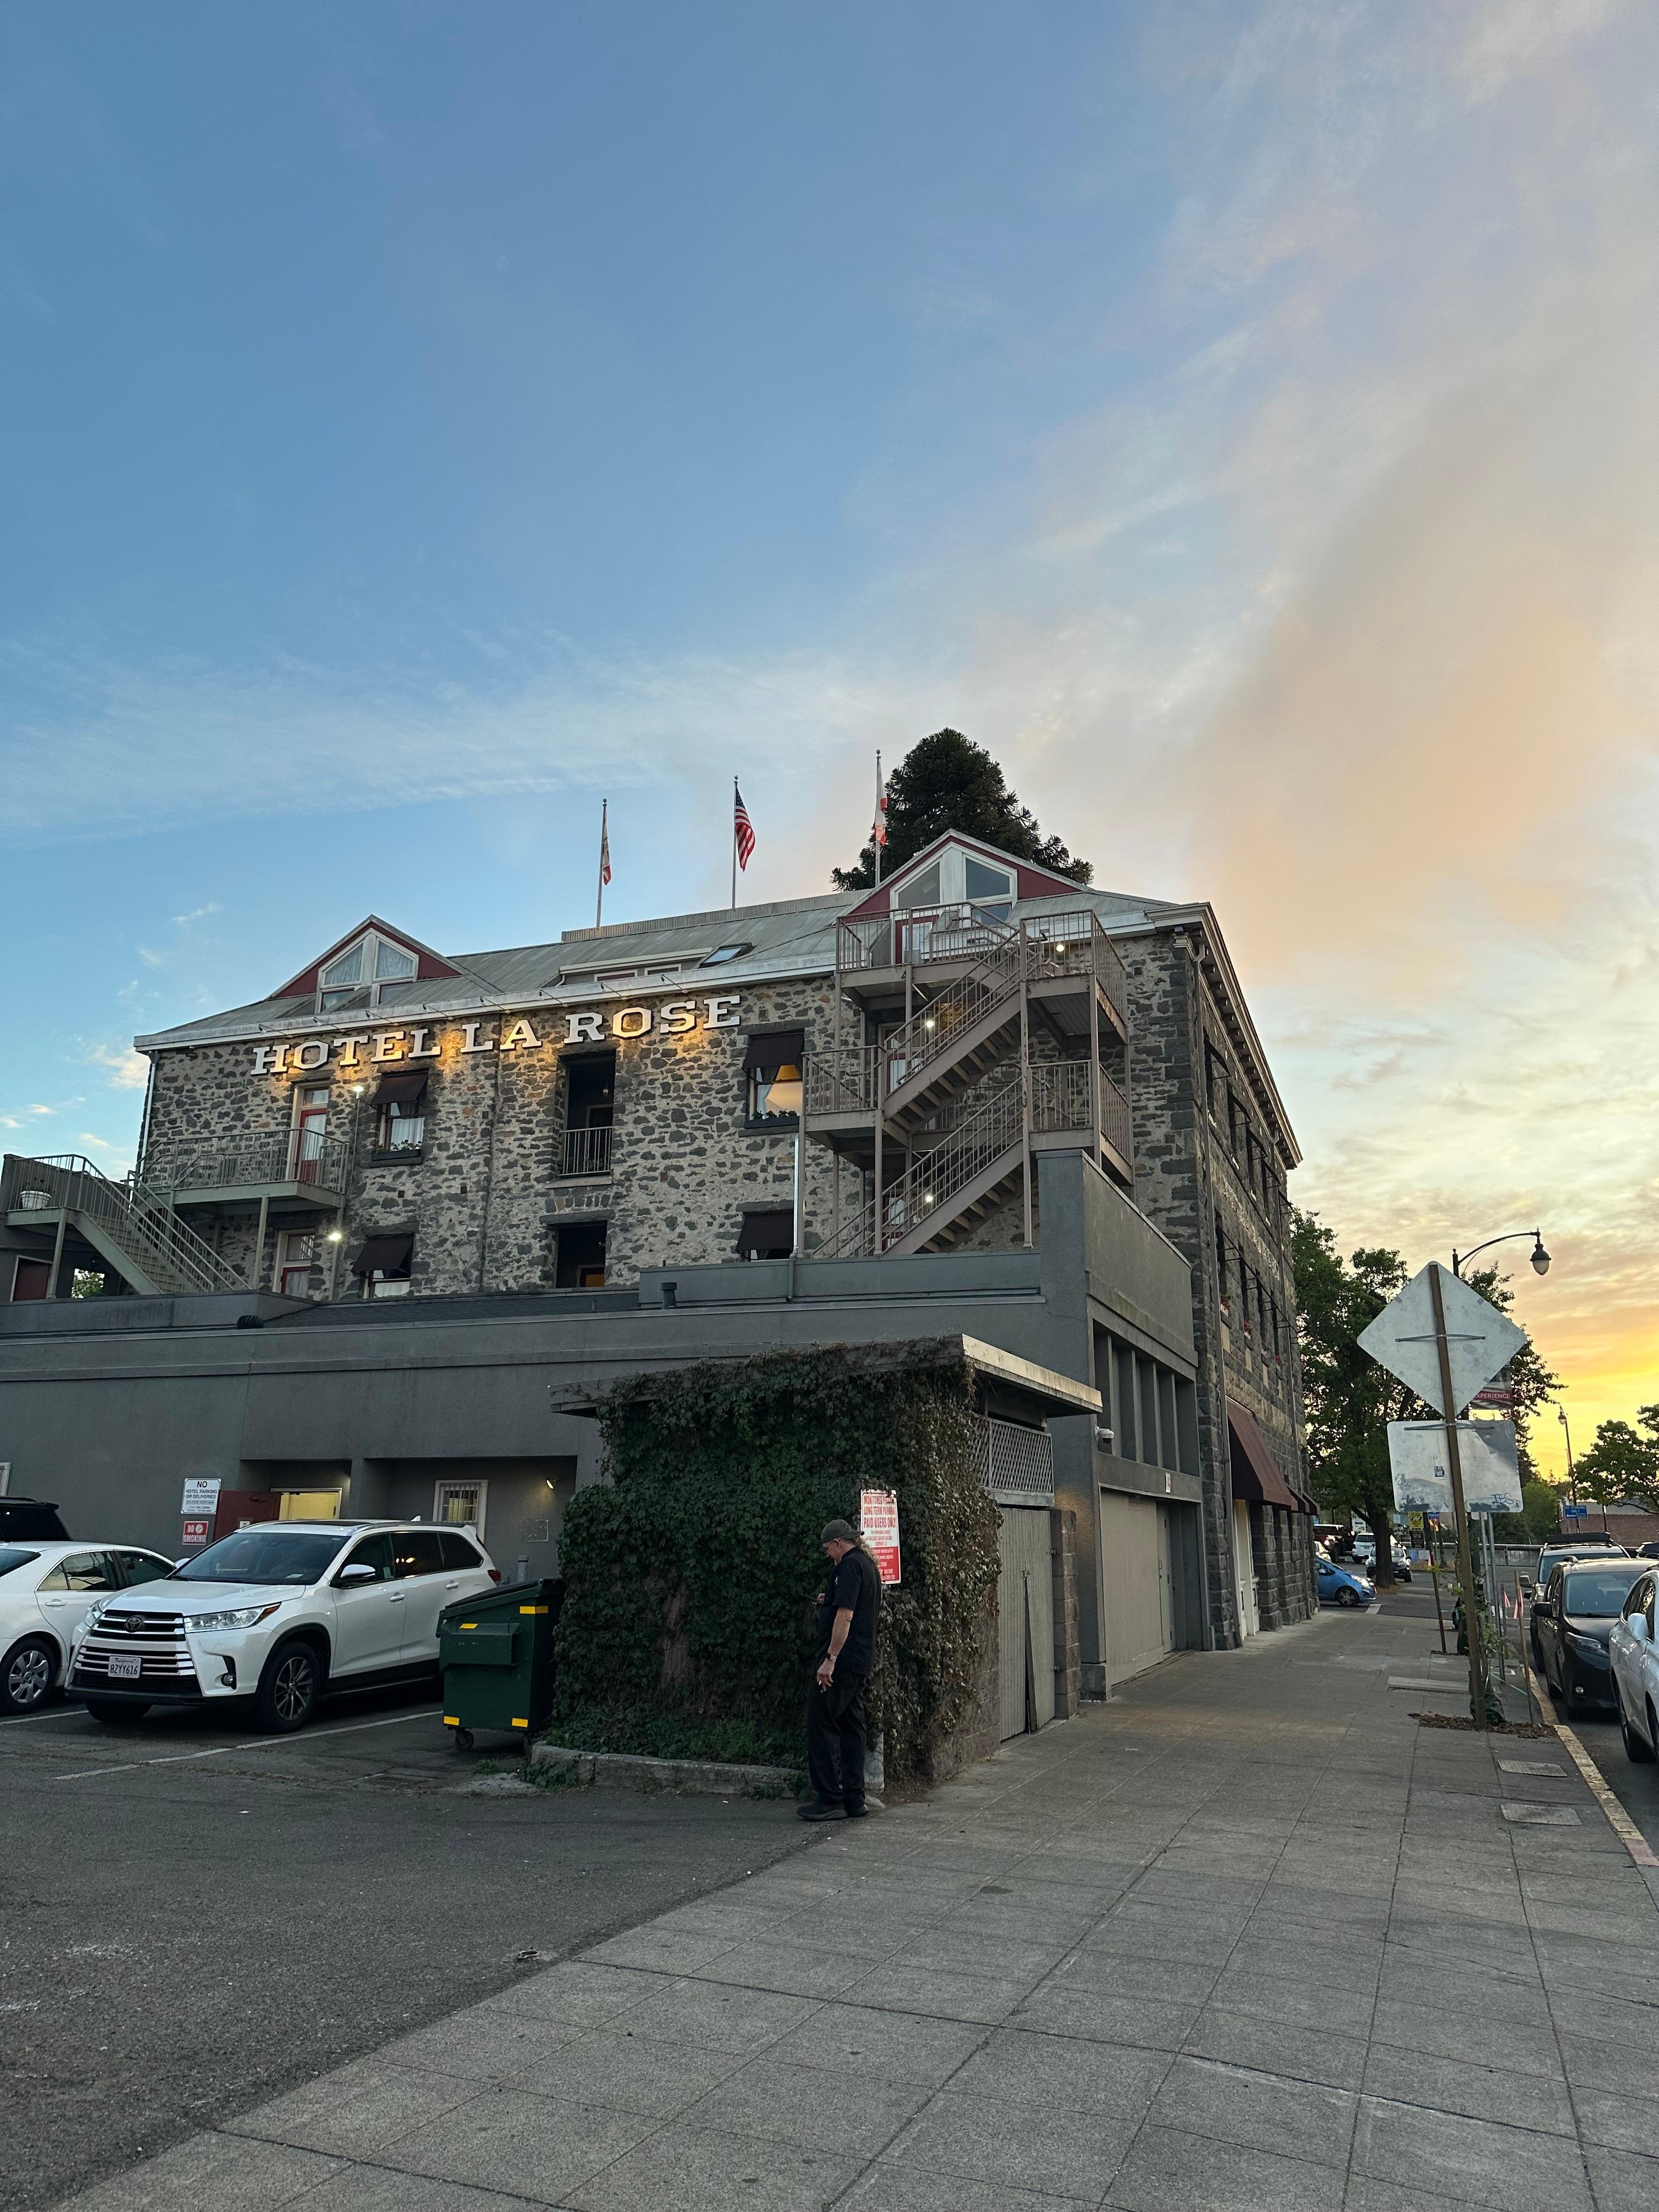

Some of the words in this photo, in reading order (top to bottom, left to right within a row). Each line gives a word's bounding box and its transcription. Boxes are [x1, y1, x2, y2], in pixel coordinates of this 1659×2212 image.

[251, 1028, 442, 1075] HOTEL
[460, 1019, 542, 1053] LA
[563, 995, 741, 1045] ROSE
[864, 1506, 873, 1515] LONG
[873, 1506, 883, 1515] TERM
[883, 1506, 895, 1515] PARKING
[864, 1517, 873, 1528] PAID
[874, 1517, 887, 1528] USERS
[887, 1517, 896, 1528] ONLY
[187, 1525, 195, 1533] NO
[183, 1534, 206, 1543] SMOKING
[110, 1664, 138, 1675] 8ZYY616
